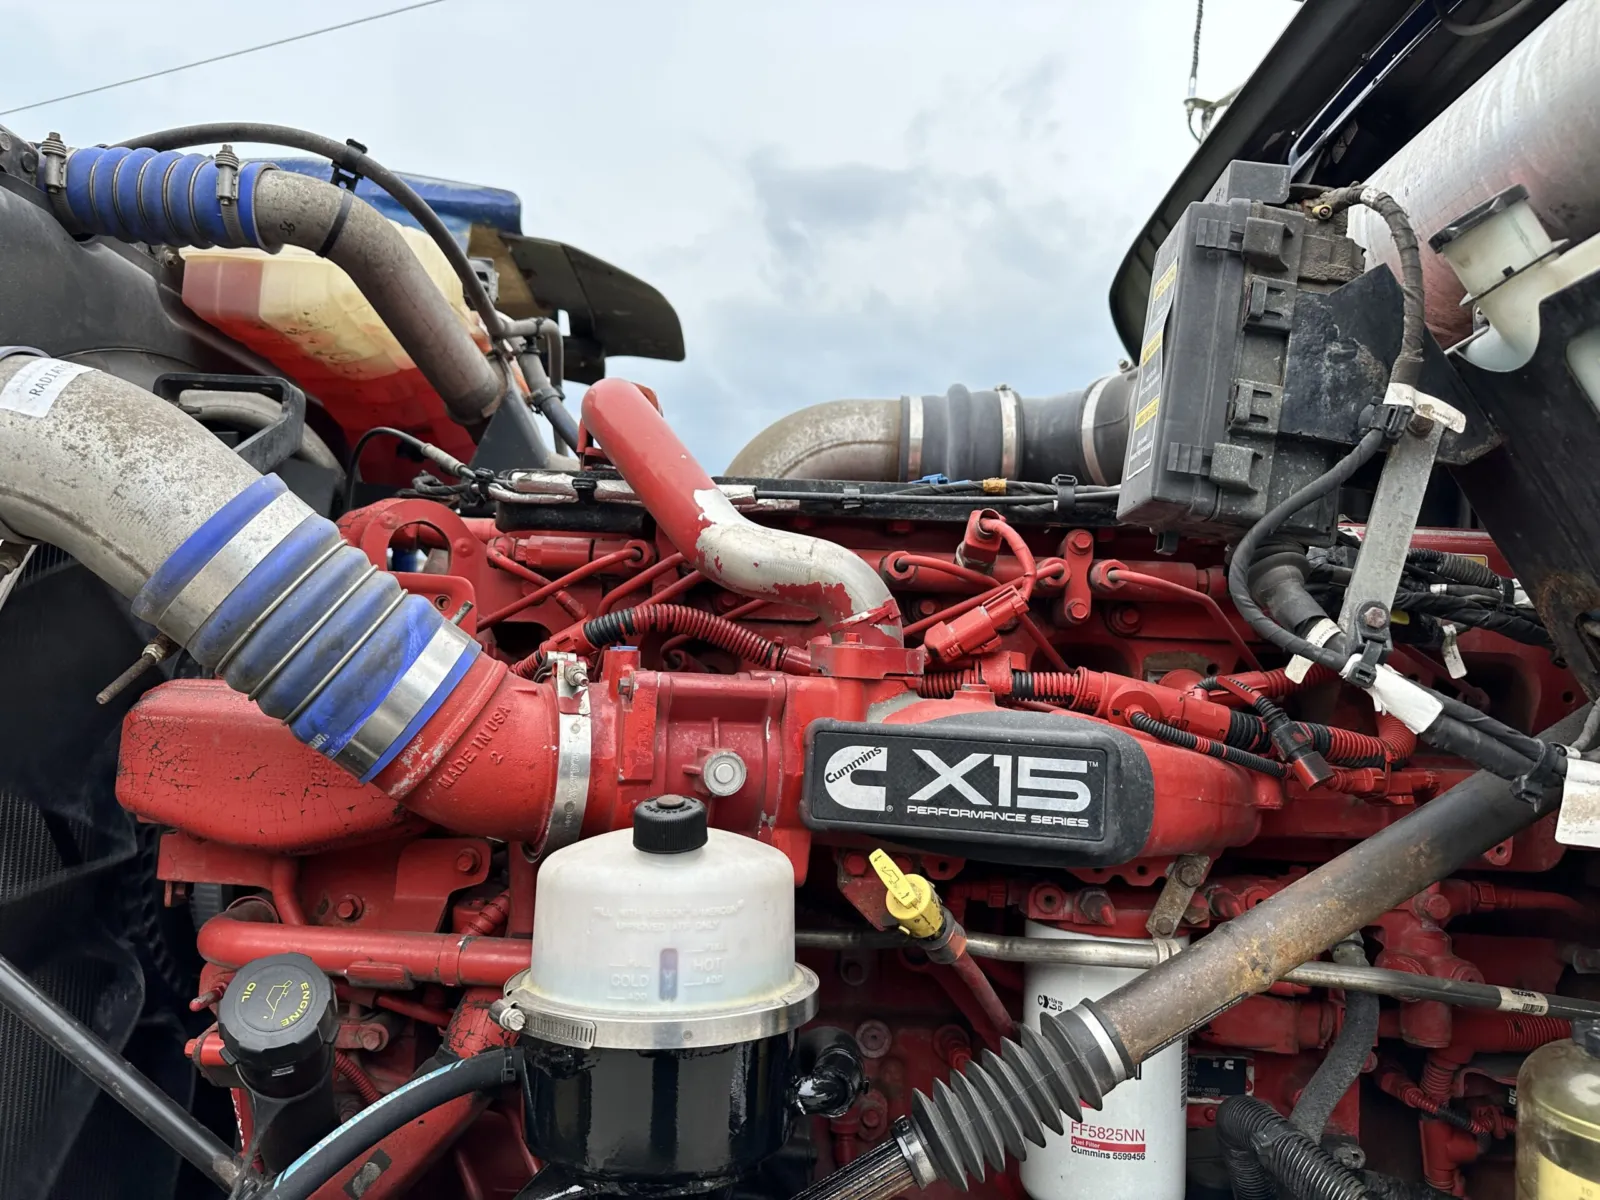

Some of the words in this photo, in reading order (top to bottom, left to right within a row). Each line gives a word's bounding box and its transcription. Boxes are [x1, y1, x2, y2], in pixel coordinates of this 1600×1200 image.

[438, 747, 477, 789] MADE
[471, 731, 493, 750] IN
[485, 705, 511, 732] USA
[490, 750, 504, 766] 2
[825, 746, 882, 784] Cummins
[907, 749, 1092, 813] X15
[906, 805, 1027, 823] PERFORMANCE
[1030, 814, 1090, 829] SERIES
[693, 957, 724, 972] HOT
[611, 973, 649, 987] COLD
[240, 982, 257, 1003] OIL
[280, 981, 310, 1027] ENGINE
[1070, 1120, 1146, 1142] FF5825NN
[1070, 1145, 1111, 1159] Cummins
[1112, 1152, 1146, 1161] 5599456
